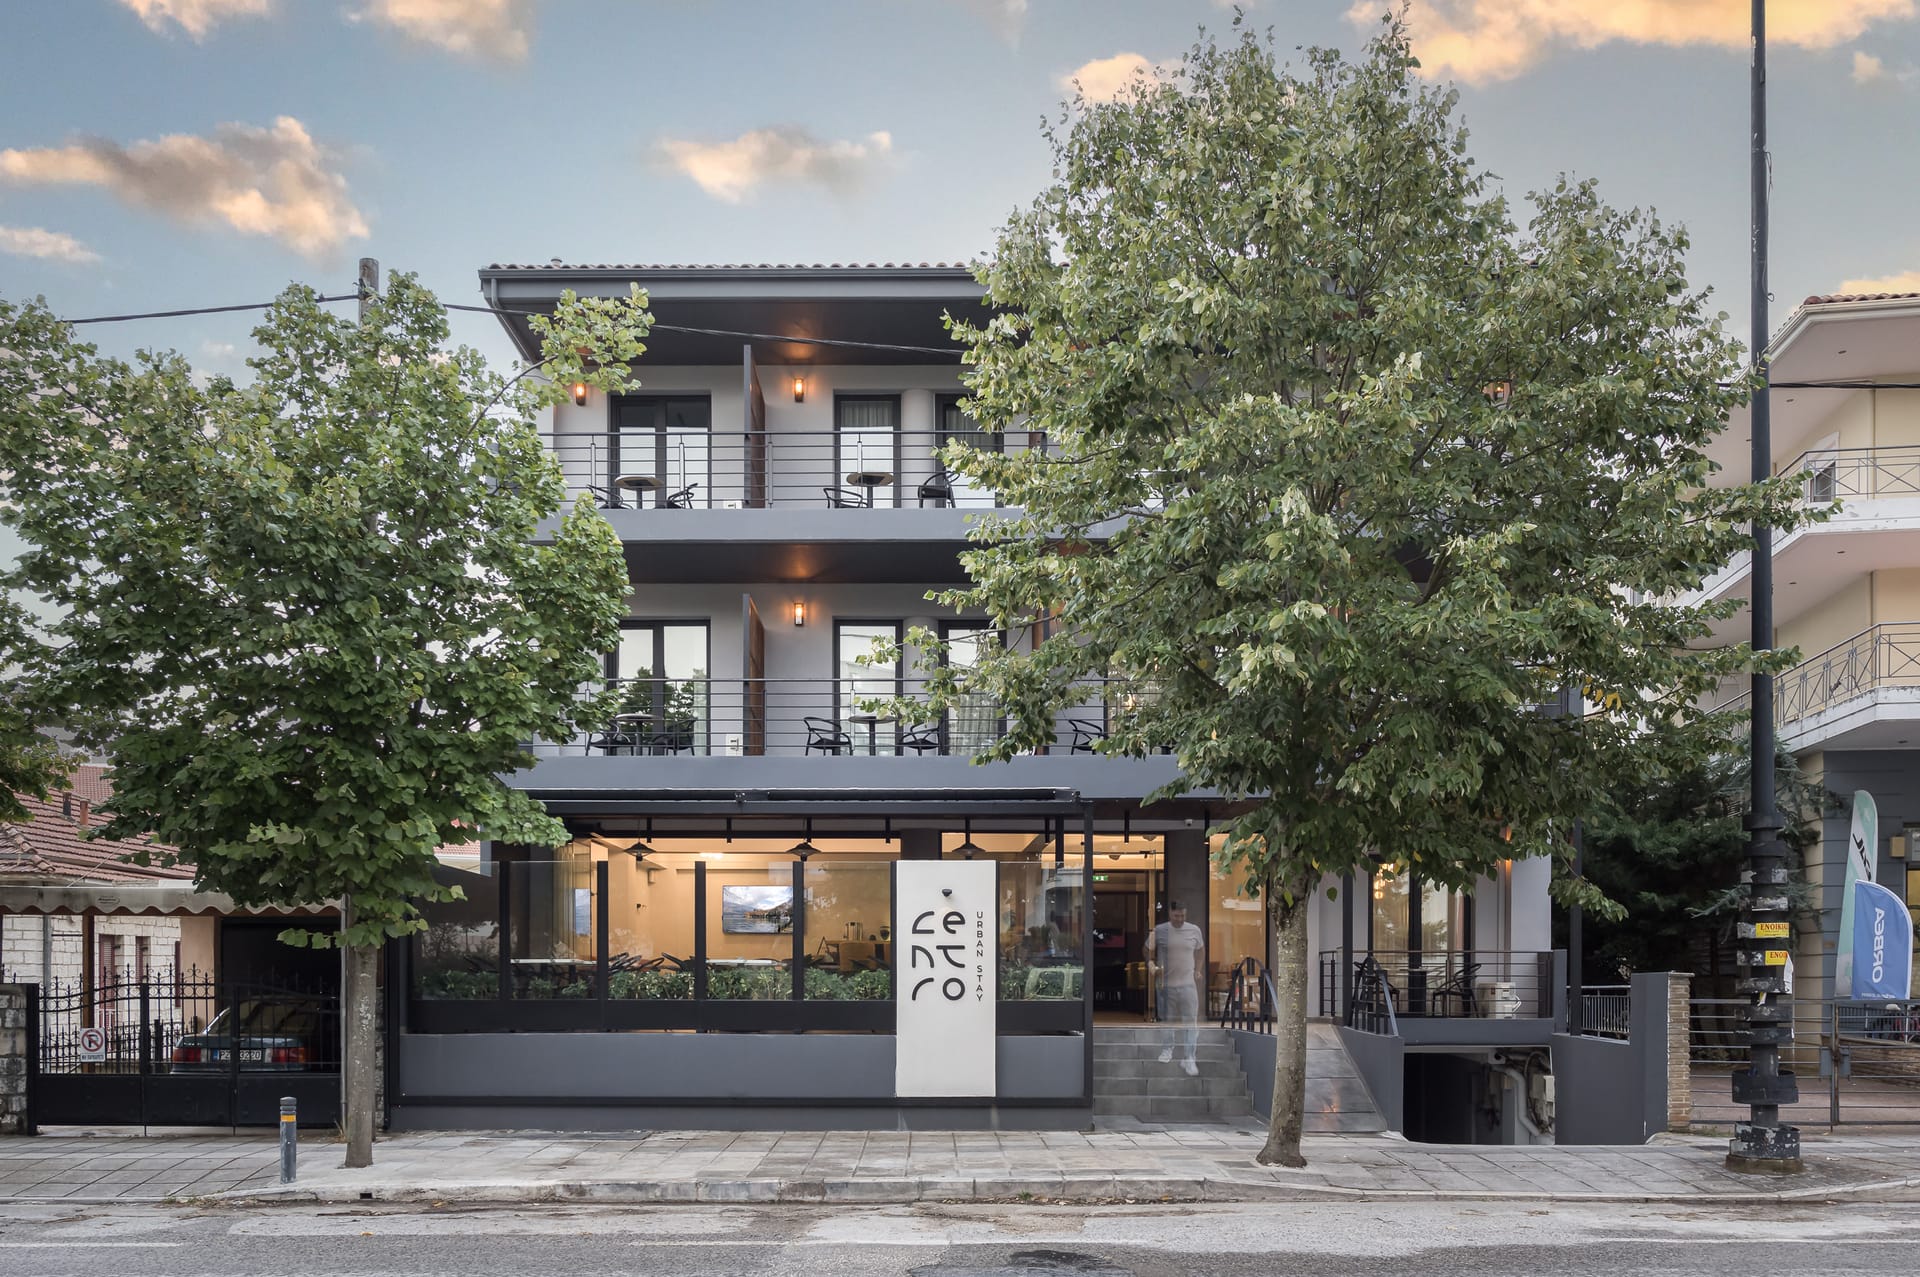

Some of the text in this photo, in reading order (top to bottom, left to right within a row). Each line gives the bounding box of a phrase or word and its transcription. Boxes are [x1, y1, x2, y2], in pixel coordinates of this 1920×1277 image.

[976, 911, 984, 1001] URBAN STAY
[1872, 907, 1885, 984] ORBEA
